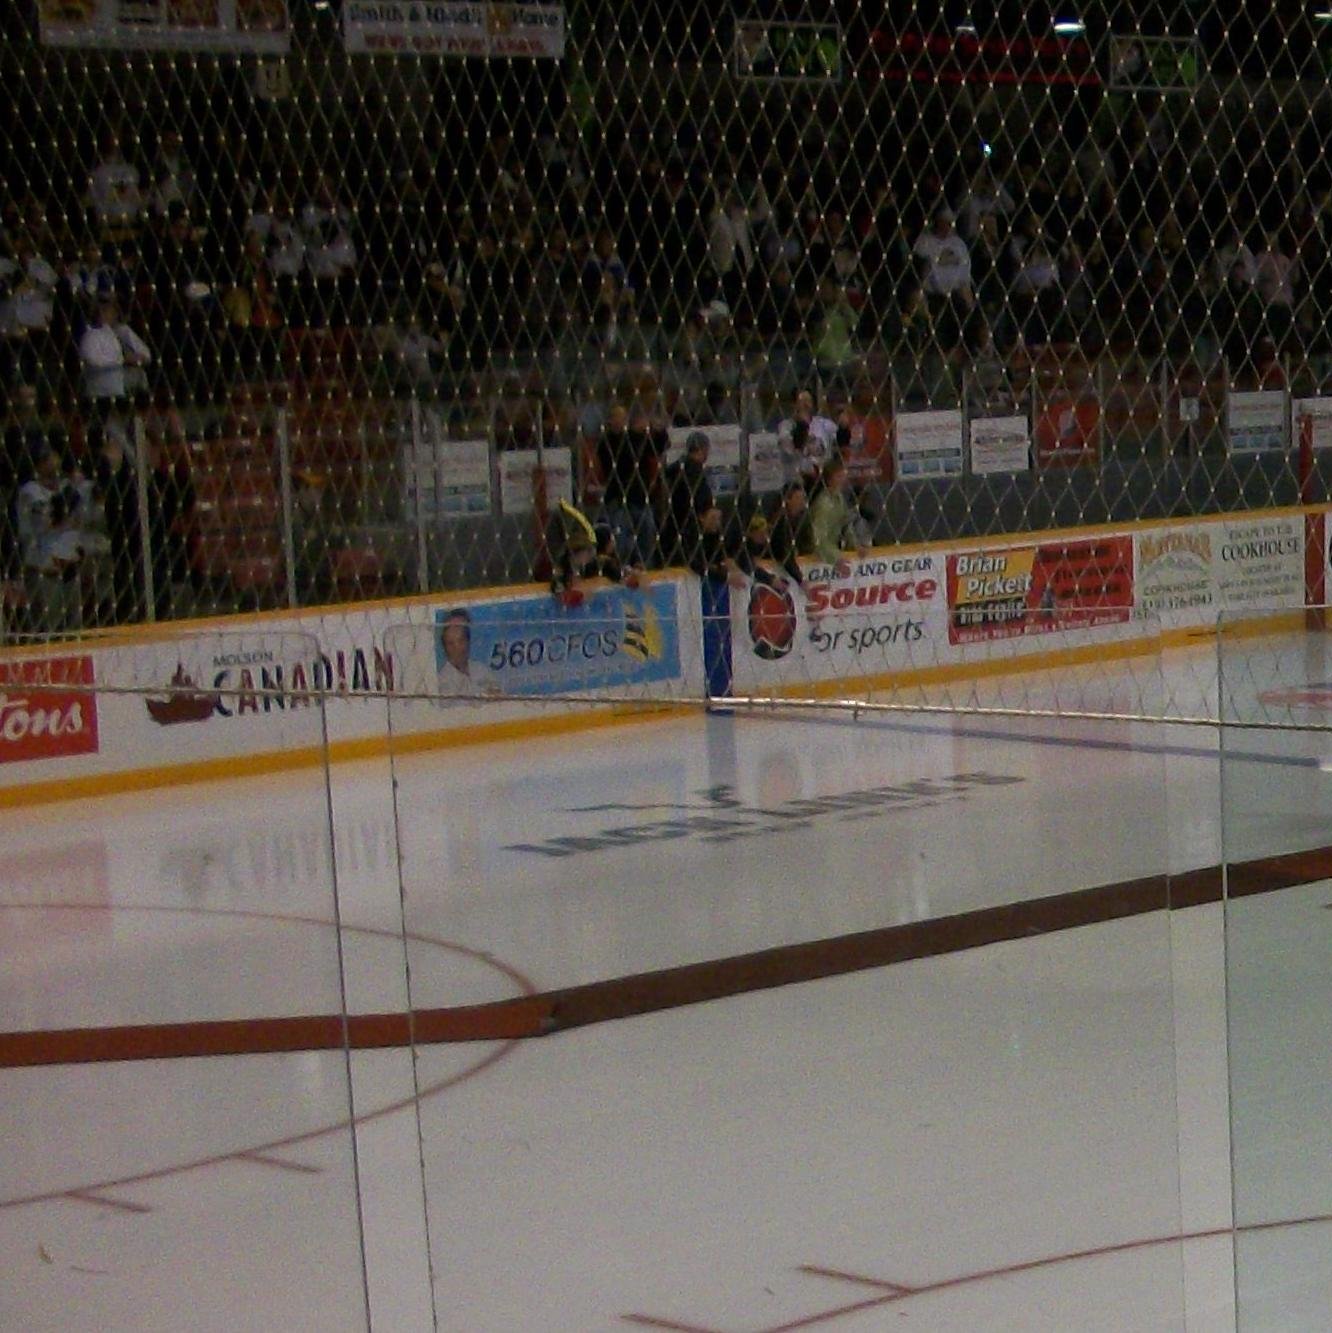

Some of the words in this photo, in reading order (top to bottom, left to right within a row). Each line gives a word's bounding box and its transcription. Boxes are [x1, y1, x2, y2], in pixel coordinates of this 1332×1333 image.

[856, 562, 887, 577] AND
[892, 557, 932, 574] GEAR
[956, 556, 1007, 576] Brian
[805, 579, 937, 614] Source
[967, 574, 1033, 598] Pickett
[847, 618, 924, 654] sports
[213, 650, 274, 667] MOLSON
[213, 646, 394, 717] CANADIAN
